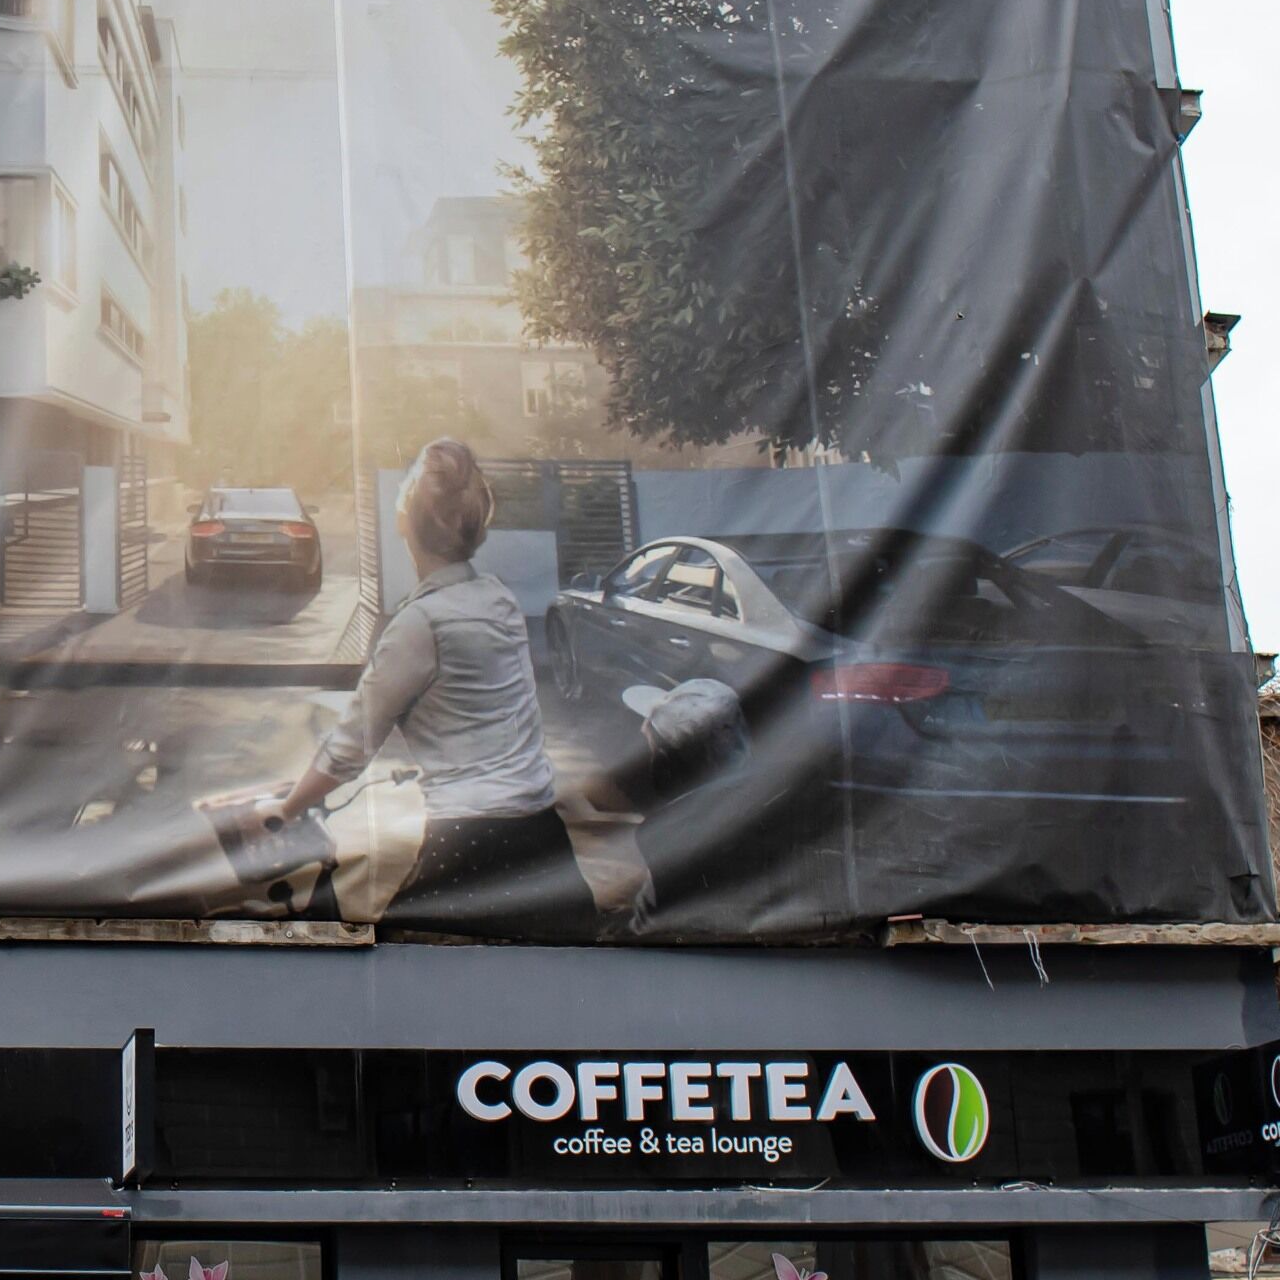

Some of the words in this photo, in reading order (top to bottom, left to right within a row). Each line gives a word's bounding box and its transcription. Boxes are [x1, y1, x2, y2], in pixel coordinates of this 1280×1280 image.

[456, 1060, 876, 1122] COFFETEA
[554, 1128, 632, 1155] coffee
[640, 1128, 660, 1154] &
[666, 1133, 705, 1154] tea
[712, 1127, 793, 1163] lounge
